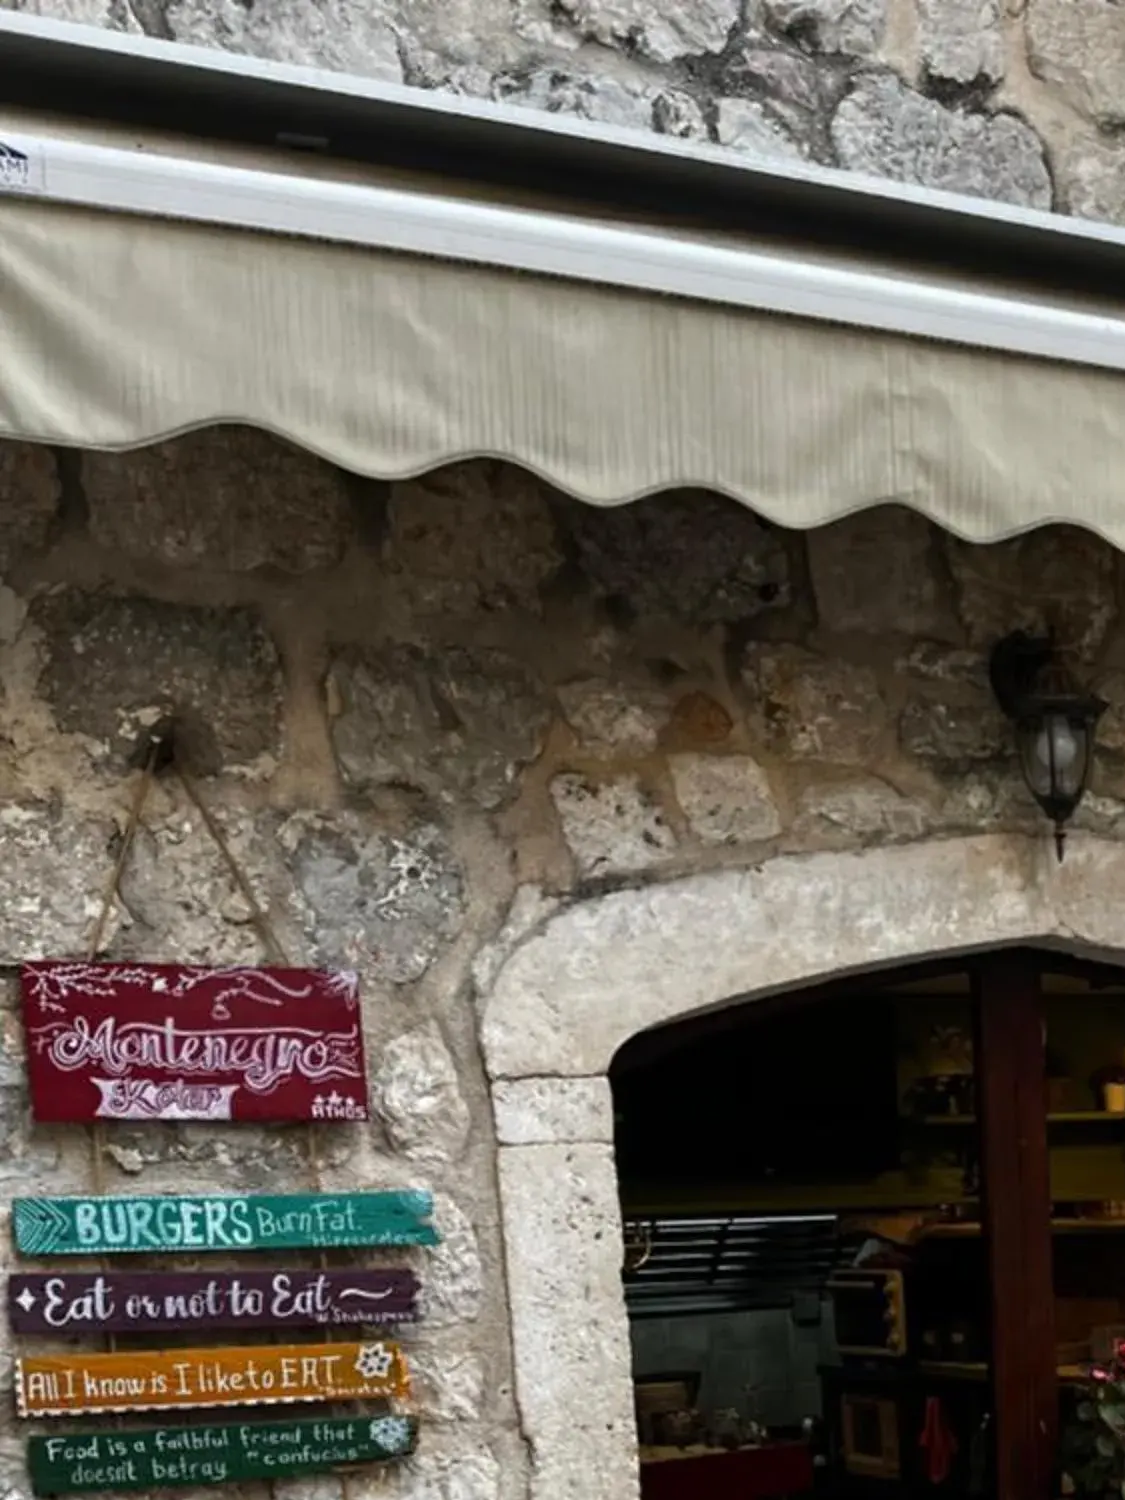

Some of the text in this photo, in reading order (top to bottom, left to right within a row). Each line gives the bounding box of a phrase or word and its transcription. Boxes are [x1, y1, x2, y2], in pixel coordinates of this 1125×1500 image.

[48, 1015, 345, 1092] Montenegro
[75, 1199, 253, 1245] BURGERS
[255, 1206, 312, 1237] Burn
[44, 1273, 333, 1326] Eat or not to Eat
[28, 1371, 59, 1401] All
[63, 1370, 77, 1399] I
[84, 1368, 147, 1398] know
[152, 1370, 169, 1396] is
[173, 1362, 193, 1396] I
[44, 1424, 356, 1463] Food is a faithful friend that
[152, 1454, 228, 1482] betray
